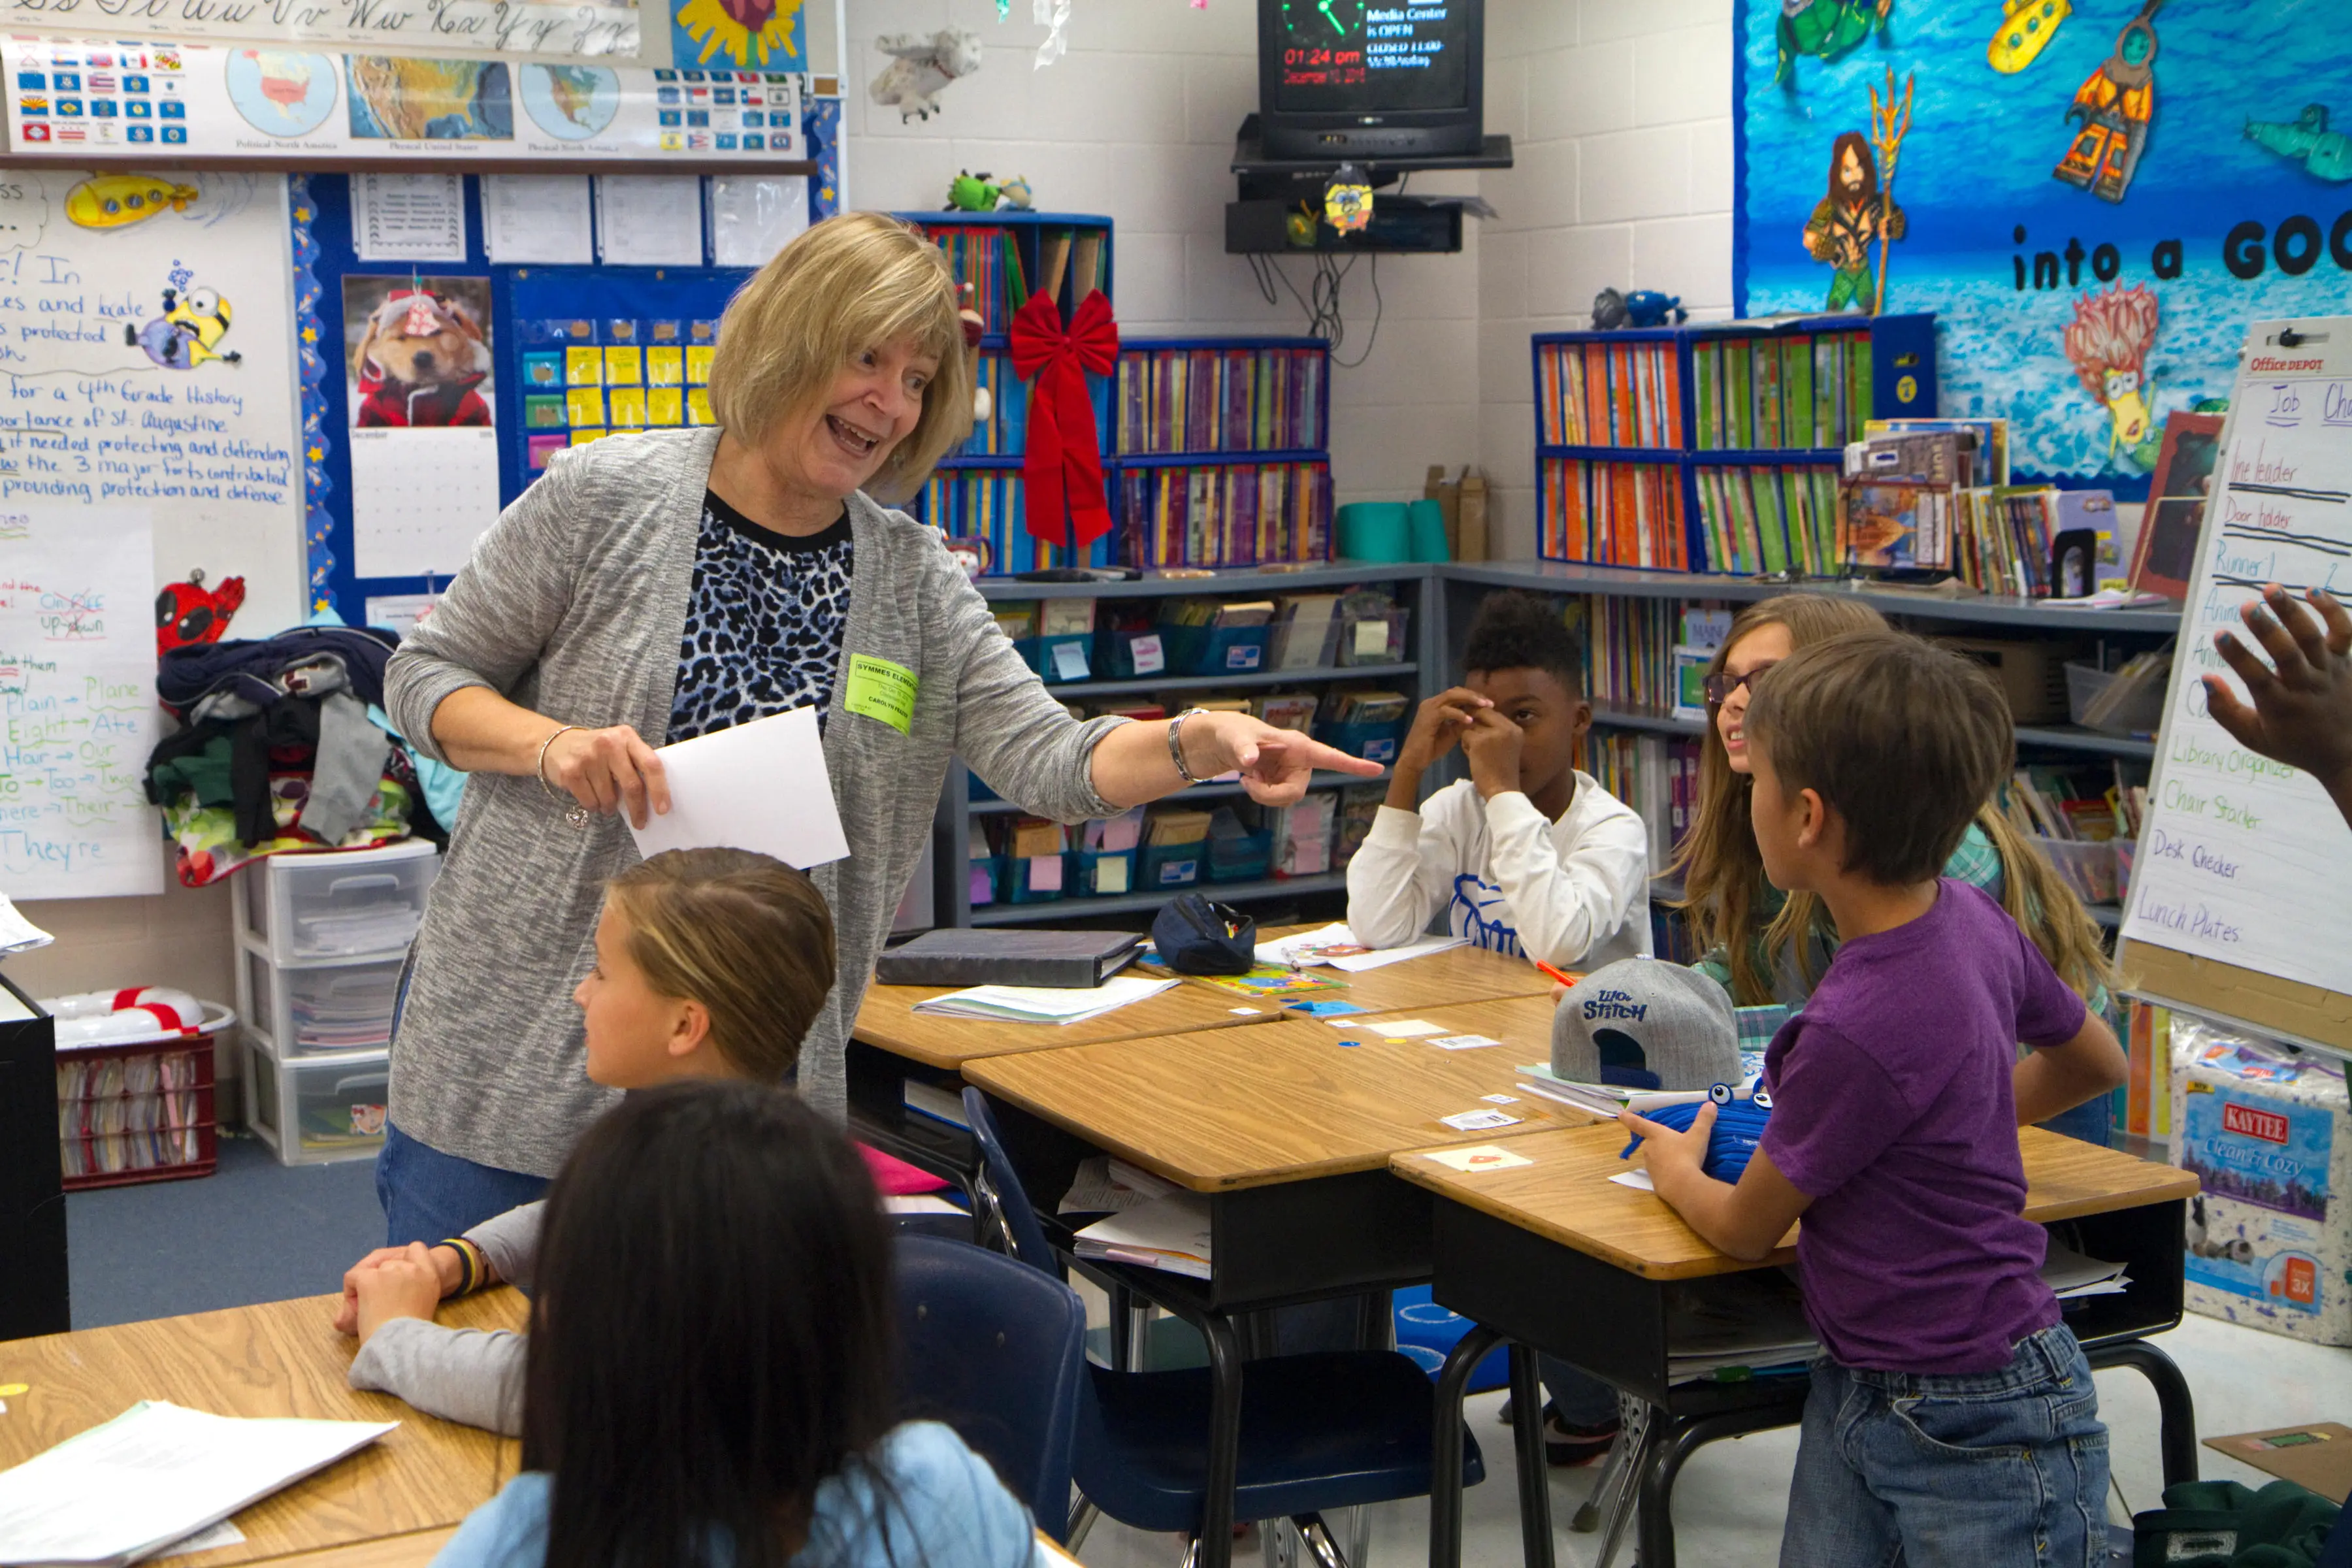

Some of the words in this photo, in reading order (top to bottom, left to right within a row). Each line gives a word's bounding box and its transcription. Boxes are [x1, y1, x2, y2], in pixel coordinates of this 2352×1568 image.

[1367, 8, 1404, 22] Media
[1406, 8, 1448, 21] Center
[1367, 26, 1377, 37] is
[1379, 24, 1413, 37] OPEN
[1335, 51, 1360, 64] pm
[274, 140, 299, 149] North
[303, 140, 338, 150] America
[36, 255, 80, 284] In
[2014, 224, 2120, 291] into
[2152, 239, 2182, 280] a
[39, 295, 84, 314] and
[22, 319, 106, 342] protected
[2251, 357, 2286, 371] Office
[2287, 359, 2324, 370] DEPOT
[9, 374, 44, 399] for
[54, 387, 68, 402] a
[78, 379, 116, 404] 4th
[121, 379, 174, 403] Grade
[187, 384, 243, 416] History
[2270, 384, 2300, 414] Job
[84, 406, 105, 427] of
[98, 434, 184, 461] protecting
[189, 438, 219, 457] and
[27, 453, 63, 472] the
[73, 455, 91, 472] 3
[3, 478, 93, 504] providing
[101, 478, 186, 499] protection
[189, 483, 220, 499] and
[2225, 495, 2253, 523] Door
[2215, 539, 2268, 577] Runner
[857, 663, 890, 677] SYMMES
[7, 691, 57, 715] Plain
[84, 676, 140, 703] Plane
[868, 696, 894, 711] CAROLYN
[91, 713, 139, 734] Ate
[3, 745, 50, 766] Hour
[79, 740, 116, 760] Our
[2172, 735, 2224, 773] Library
[43, 768, 76, 791] Too
[2164, 778, 2207, 814] Chair
[2155, 828, 2184, 860] Desk
[2193, 845, 2240, 879] Checker
[2138, 885, 2188, 930] Lunch
[2191, 902, 2240, 942] Plates
[2227, 1107, 2285, 1140] KAYTEE
[2203, 1136, 2246, 1163] Clean
[2264, 1154, 2305, 1177] Cozy
[2291, 1277, 2311, 1296] 3X
